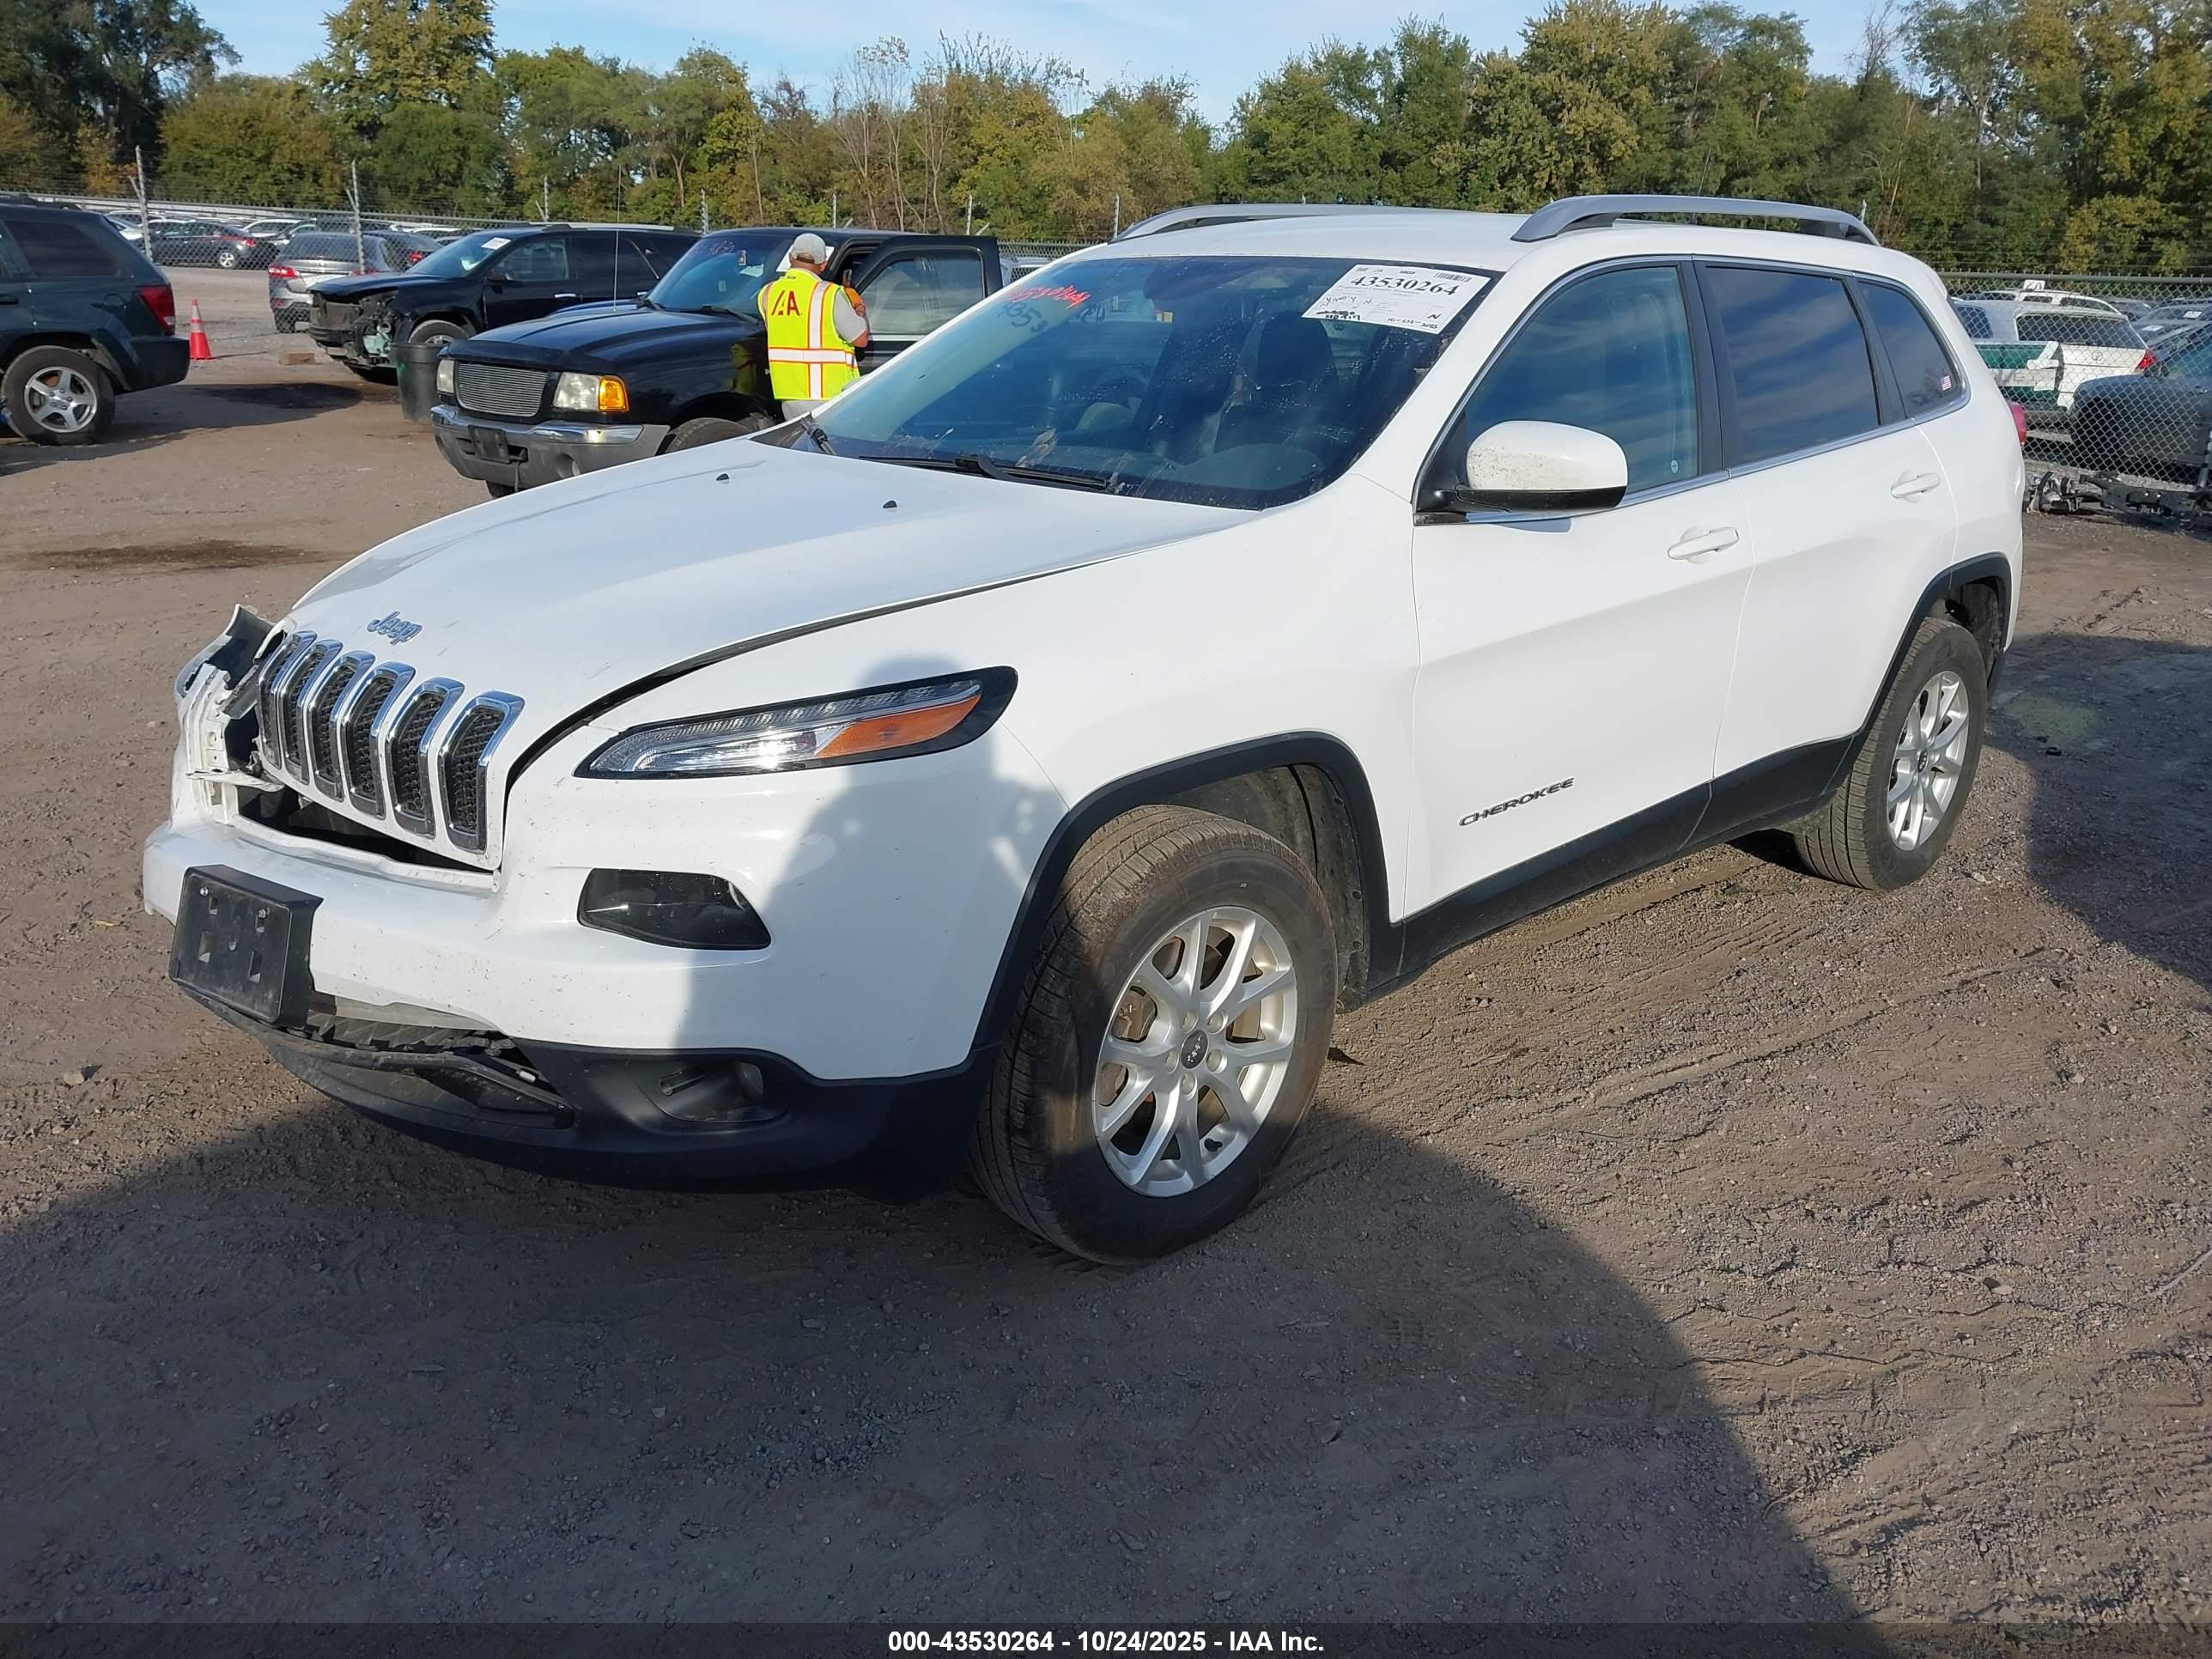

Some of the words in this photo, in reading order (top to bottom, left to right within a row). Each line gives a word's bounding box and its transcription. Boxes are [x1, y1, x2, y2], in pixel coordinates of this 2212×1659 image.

[1350, 276, 1460, 296] 43530264
[367, 611, 422, 646] Jeep
[1459, 777, 1575, 826] CHEROKEE
